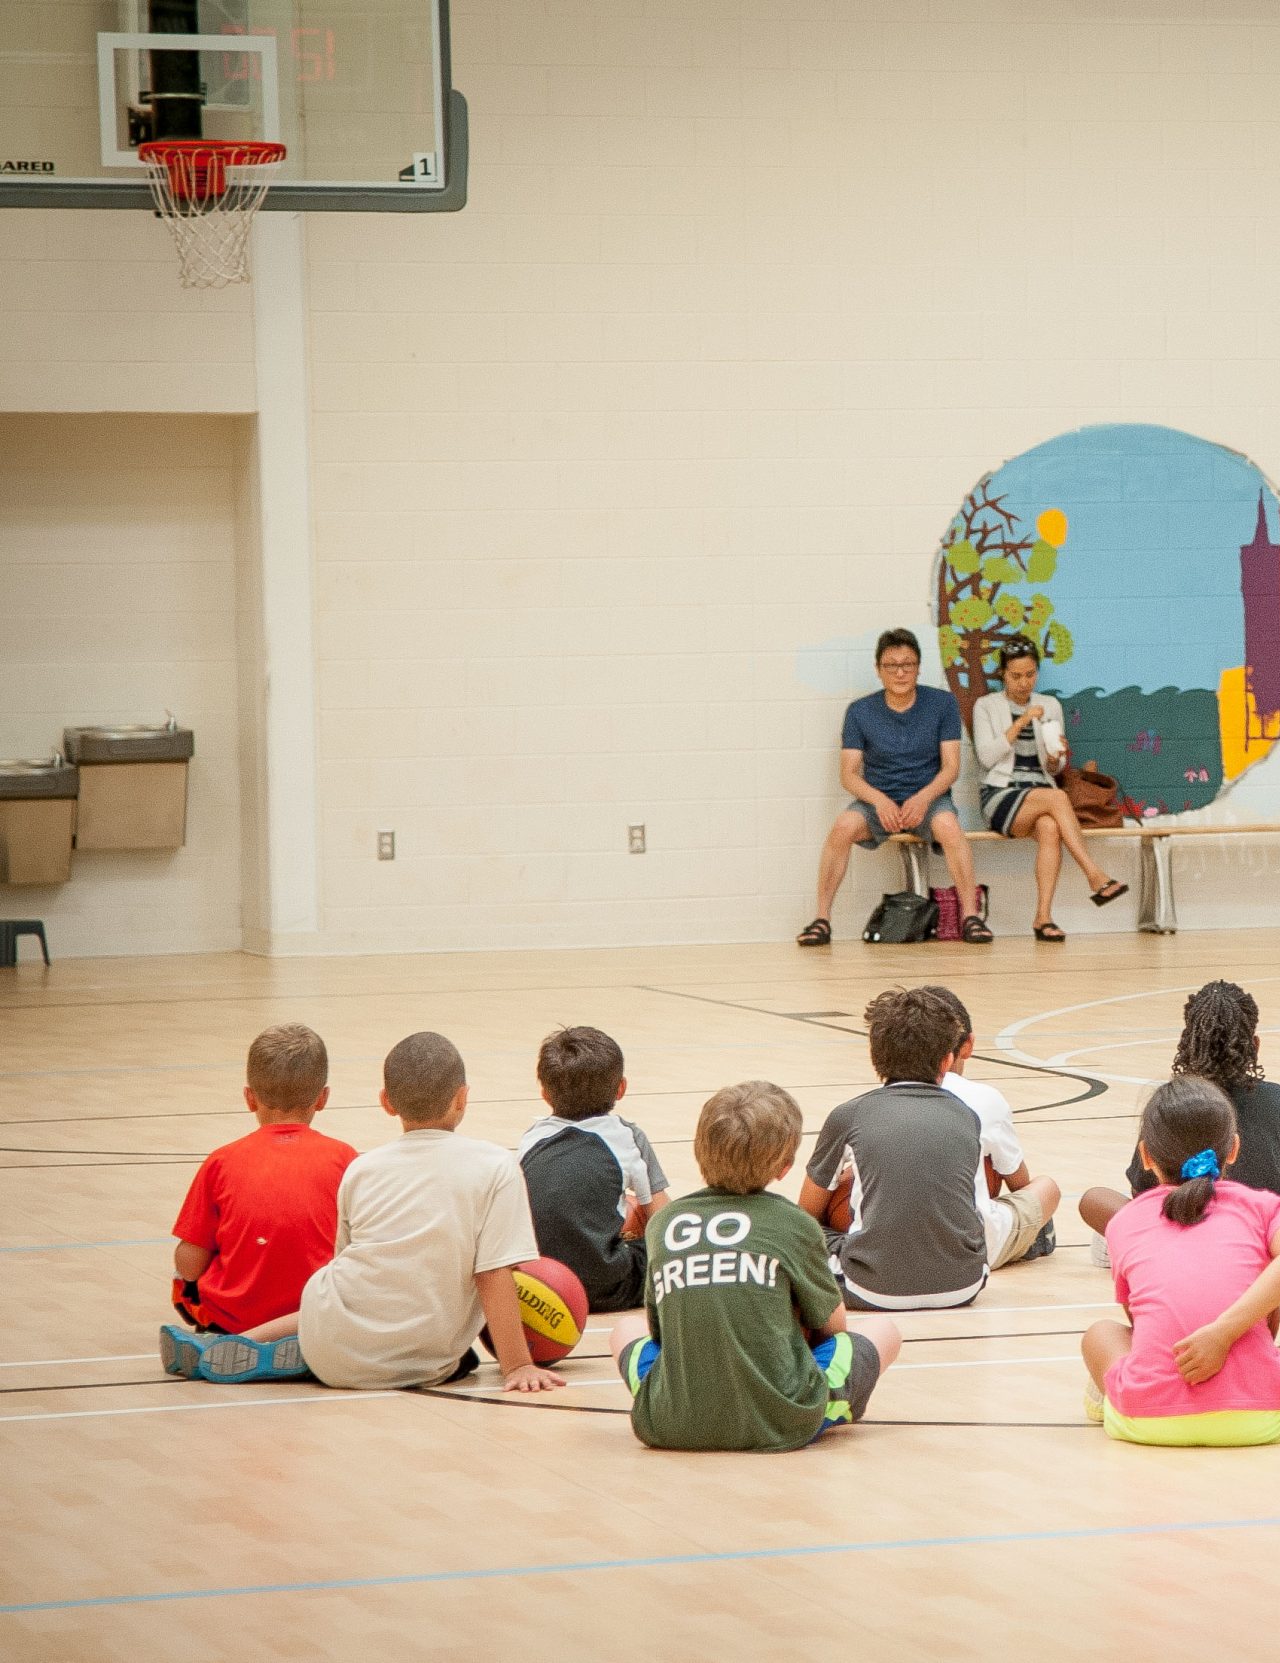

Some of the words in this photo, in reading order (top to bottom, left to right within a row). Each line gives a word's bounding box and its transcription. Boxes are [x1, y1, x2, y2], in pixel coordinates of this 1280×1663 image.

[0, 160, 54, 172] ARED
[419, 158, 431, 176] 1
[664, 1211, 751, 1251] GO
[653, 1251, 780, 1305] GREEN!
[515, 1285, 565, 1329] ALDING
